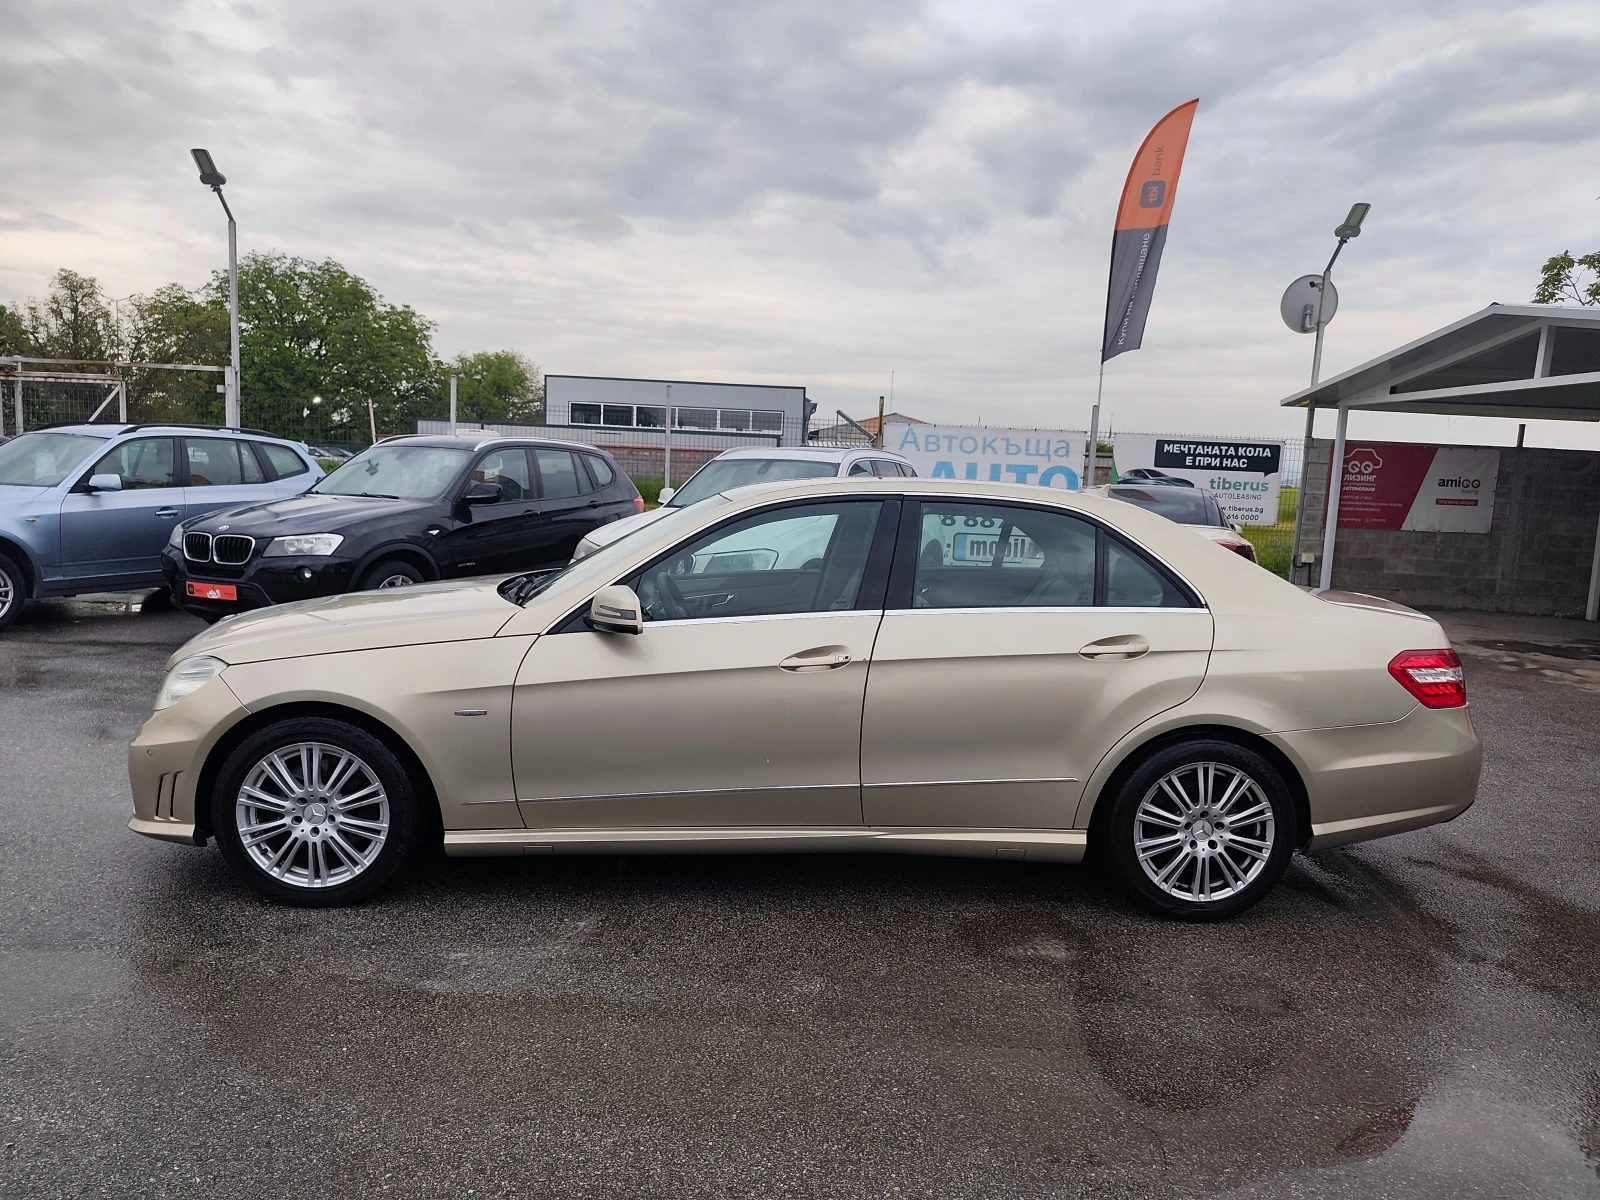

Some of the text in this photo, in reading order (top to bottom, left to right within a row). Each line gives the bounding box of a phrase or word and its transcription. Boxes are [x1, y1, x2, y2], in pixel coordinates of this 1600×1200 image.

[1148, 146, 1164, 203] tbi bank
[1117, 318, 1129, 346] Купи
[900, 427, 1070, 462] Автокъща
[1163, 443, 1271, 457] МЕЧТАНАТА КОЛА
[1185, 456, 1248, 468] Е ПРИ НАС
[1209, 477, 1269, 491] tiberus
[1343, 474, 1377, 482] ЛИЗИНГ
